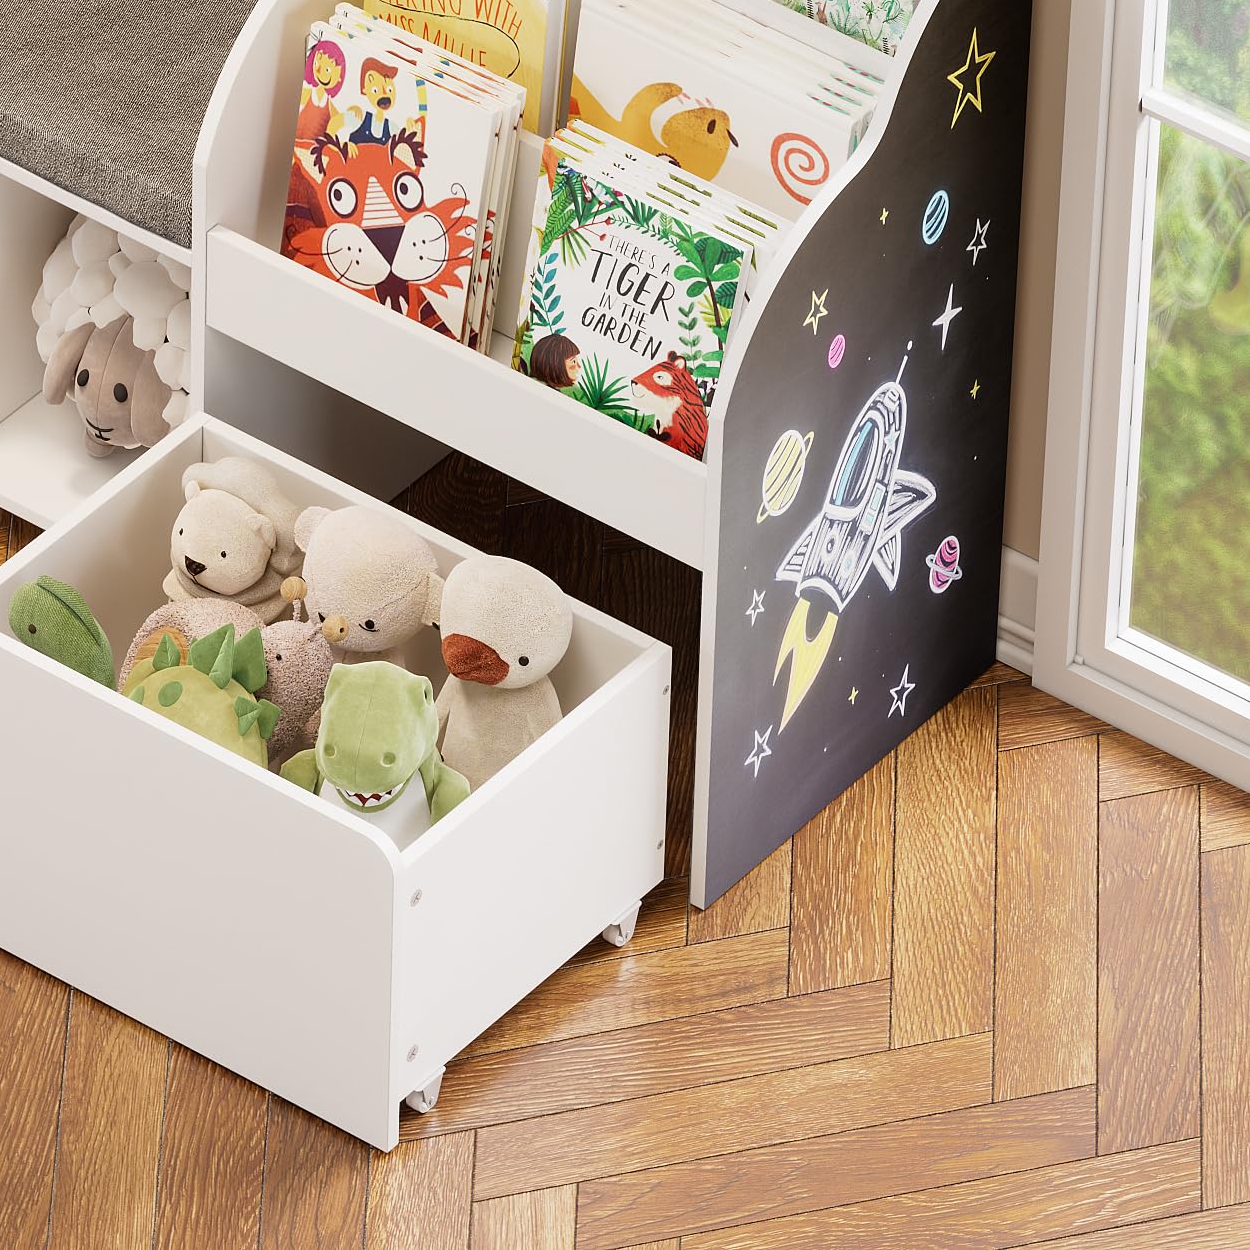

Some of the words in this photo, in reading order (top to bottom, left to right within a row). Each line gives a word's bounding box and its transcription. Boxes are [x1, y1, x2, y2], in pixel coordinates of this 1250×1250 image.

[609, 234, 657, 270] THERE'S
[661, 262, 671, 276] A
[590, 248, 676, 321] TIGER
[581, 306, 663, 361] GARDEN
[599, 292, 618, 310] IN
[621, 302, 649, 330] THE
